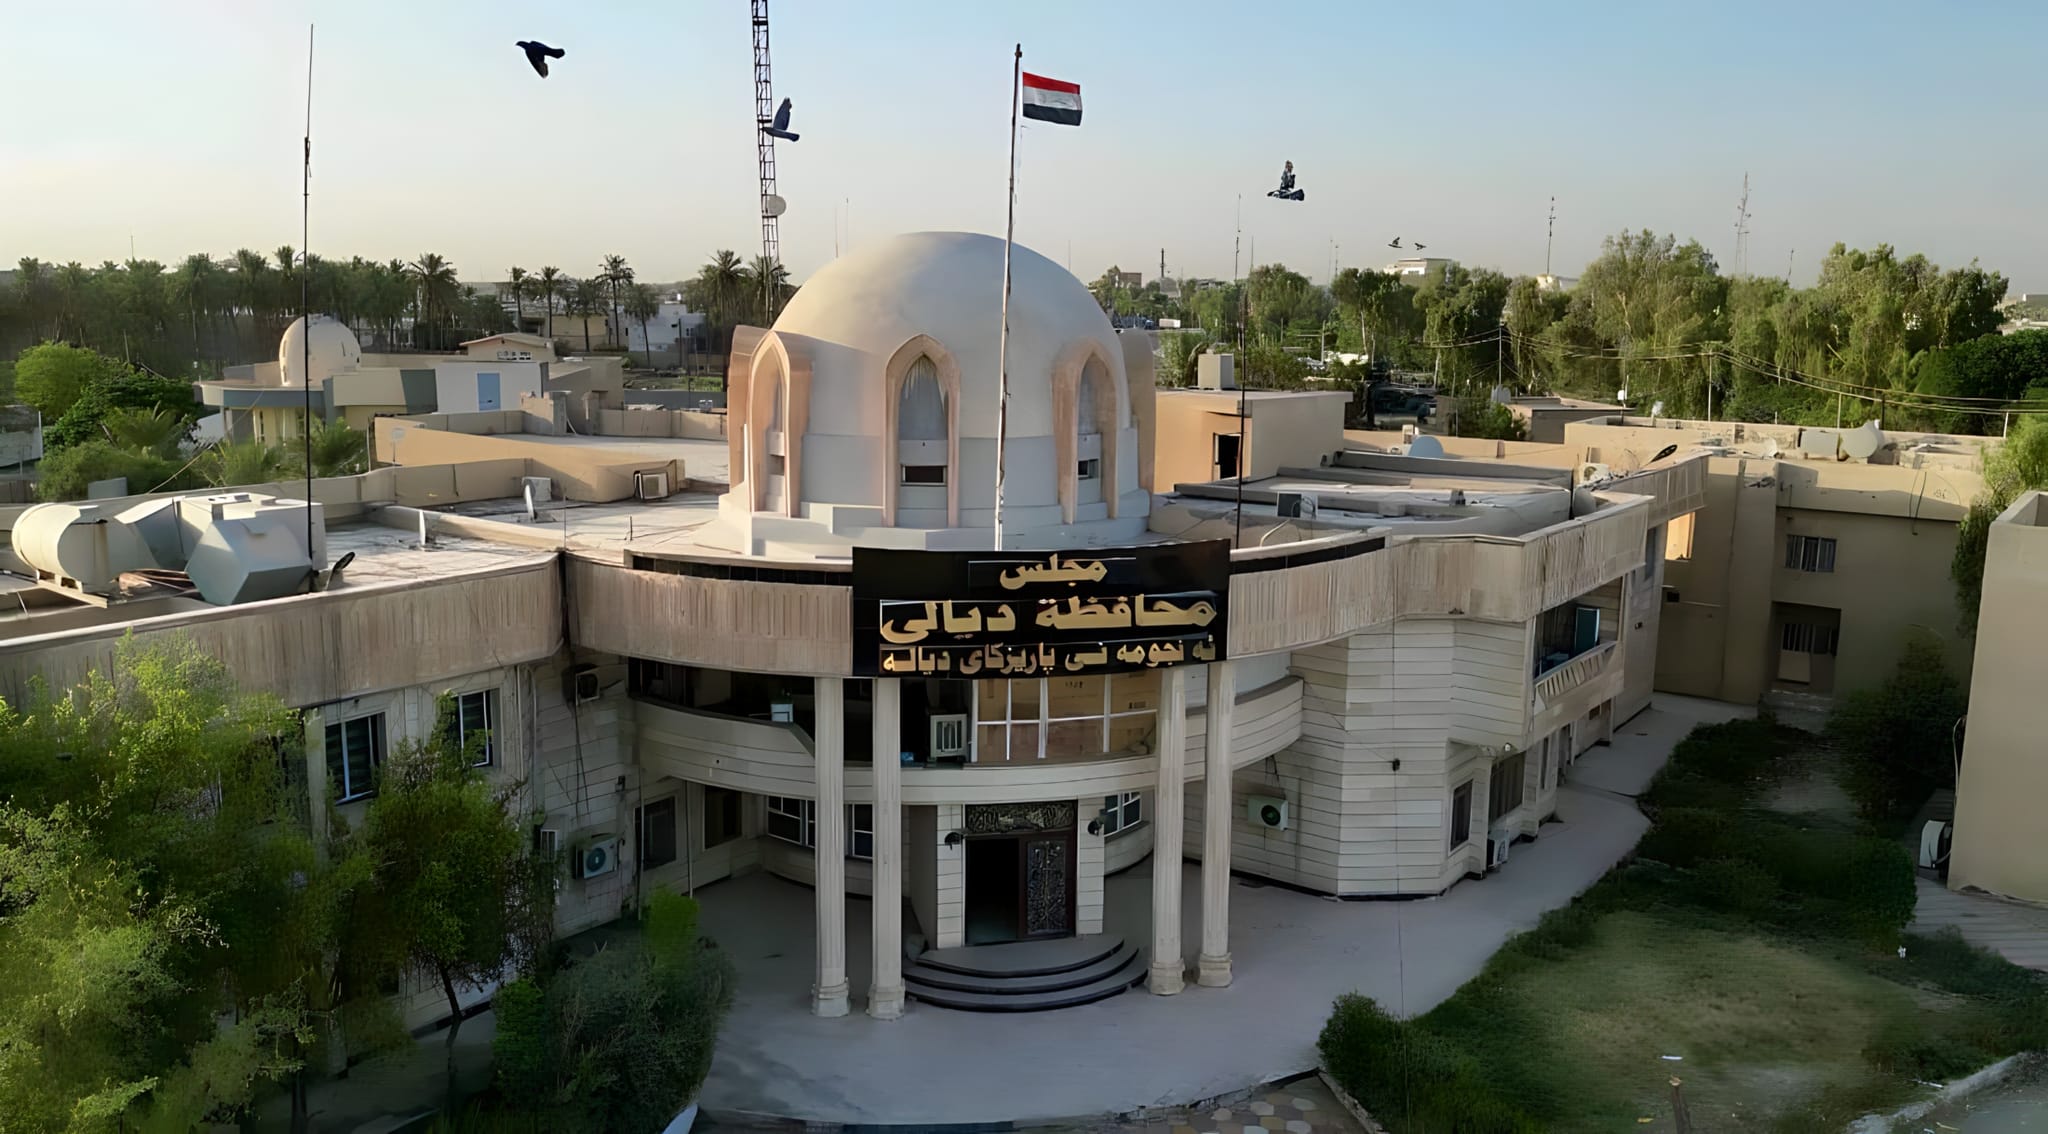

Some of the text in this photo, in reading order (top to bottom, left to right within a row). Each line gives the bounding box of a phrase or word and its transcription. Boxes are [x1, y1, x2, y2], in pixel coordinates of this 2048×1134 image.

[1000, 553, 1107, 589] مجلس
[880, 593, 1217, 643] محافظة ديالى
